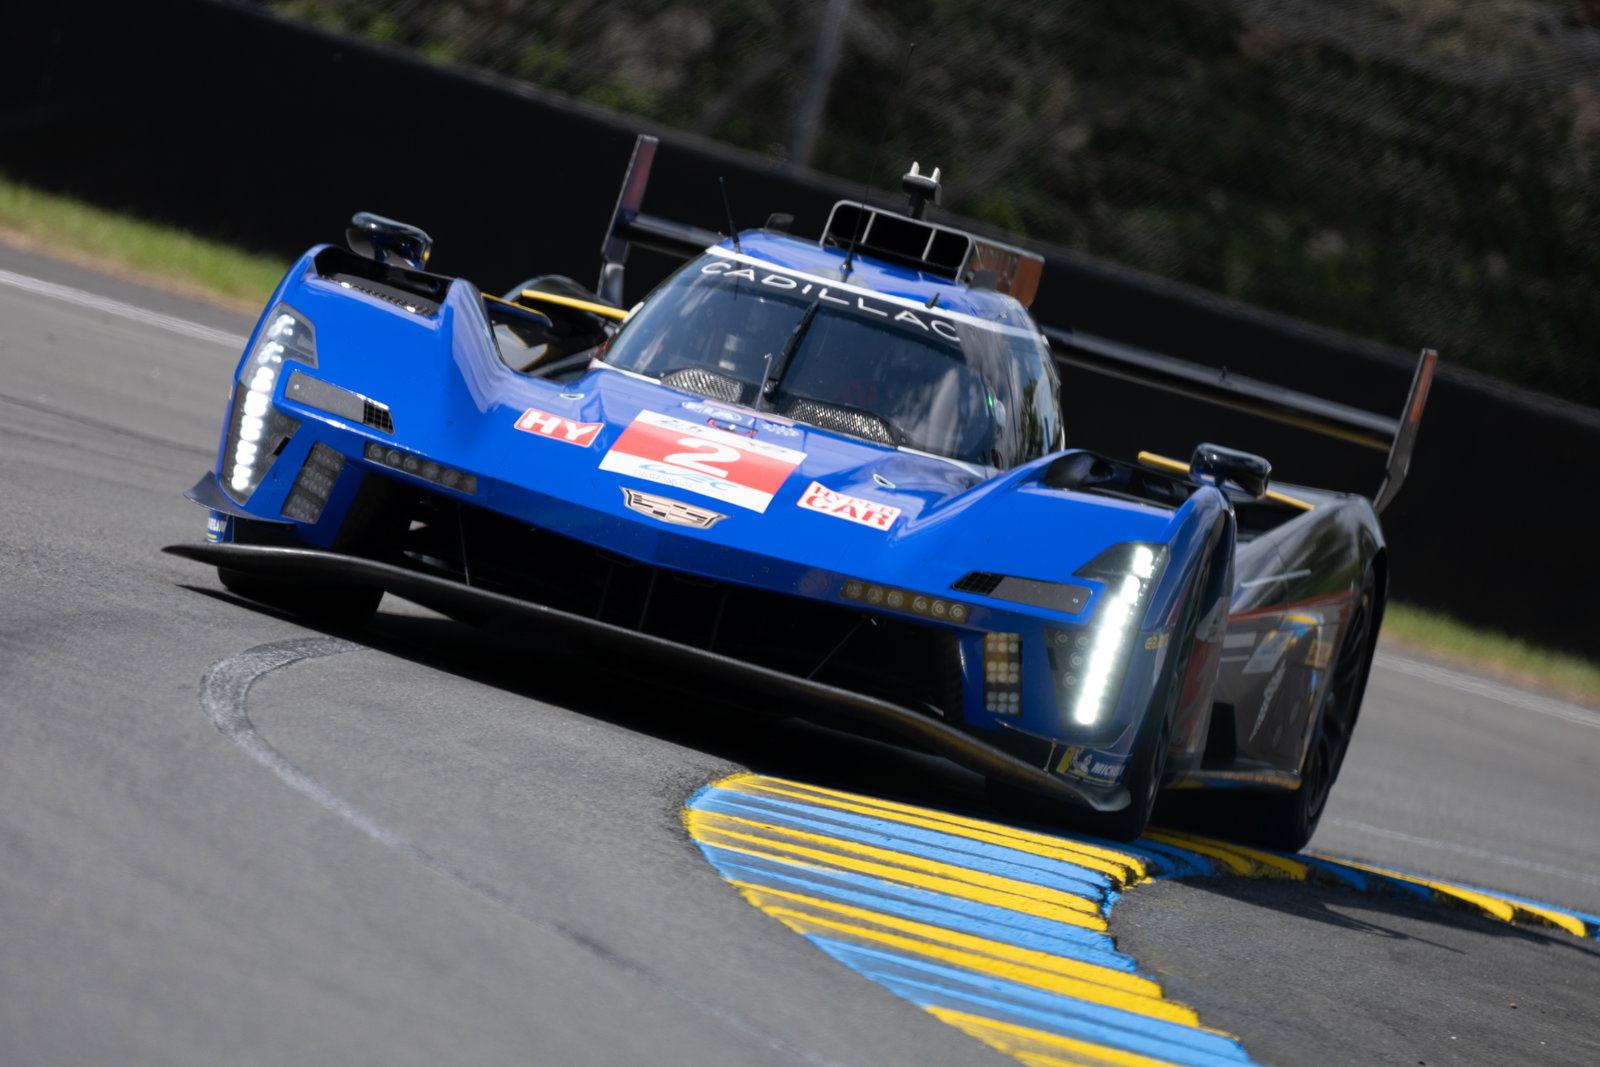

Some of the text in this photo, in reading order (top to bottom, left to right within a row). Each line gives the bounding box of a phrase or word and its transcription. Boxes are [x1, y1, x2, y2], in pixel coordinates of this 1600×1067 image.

[700, 261, 961, 342] CADILLAC
[519, 410, 598, 441] HY
[662, 436, 742, 478] 2
[638, 463, 740, 492] WEC
[805, 495, 890, 526] CAR
